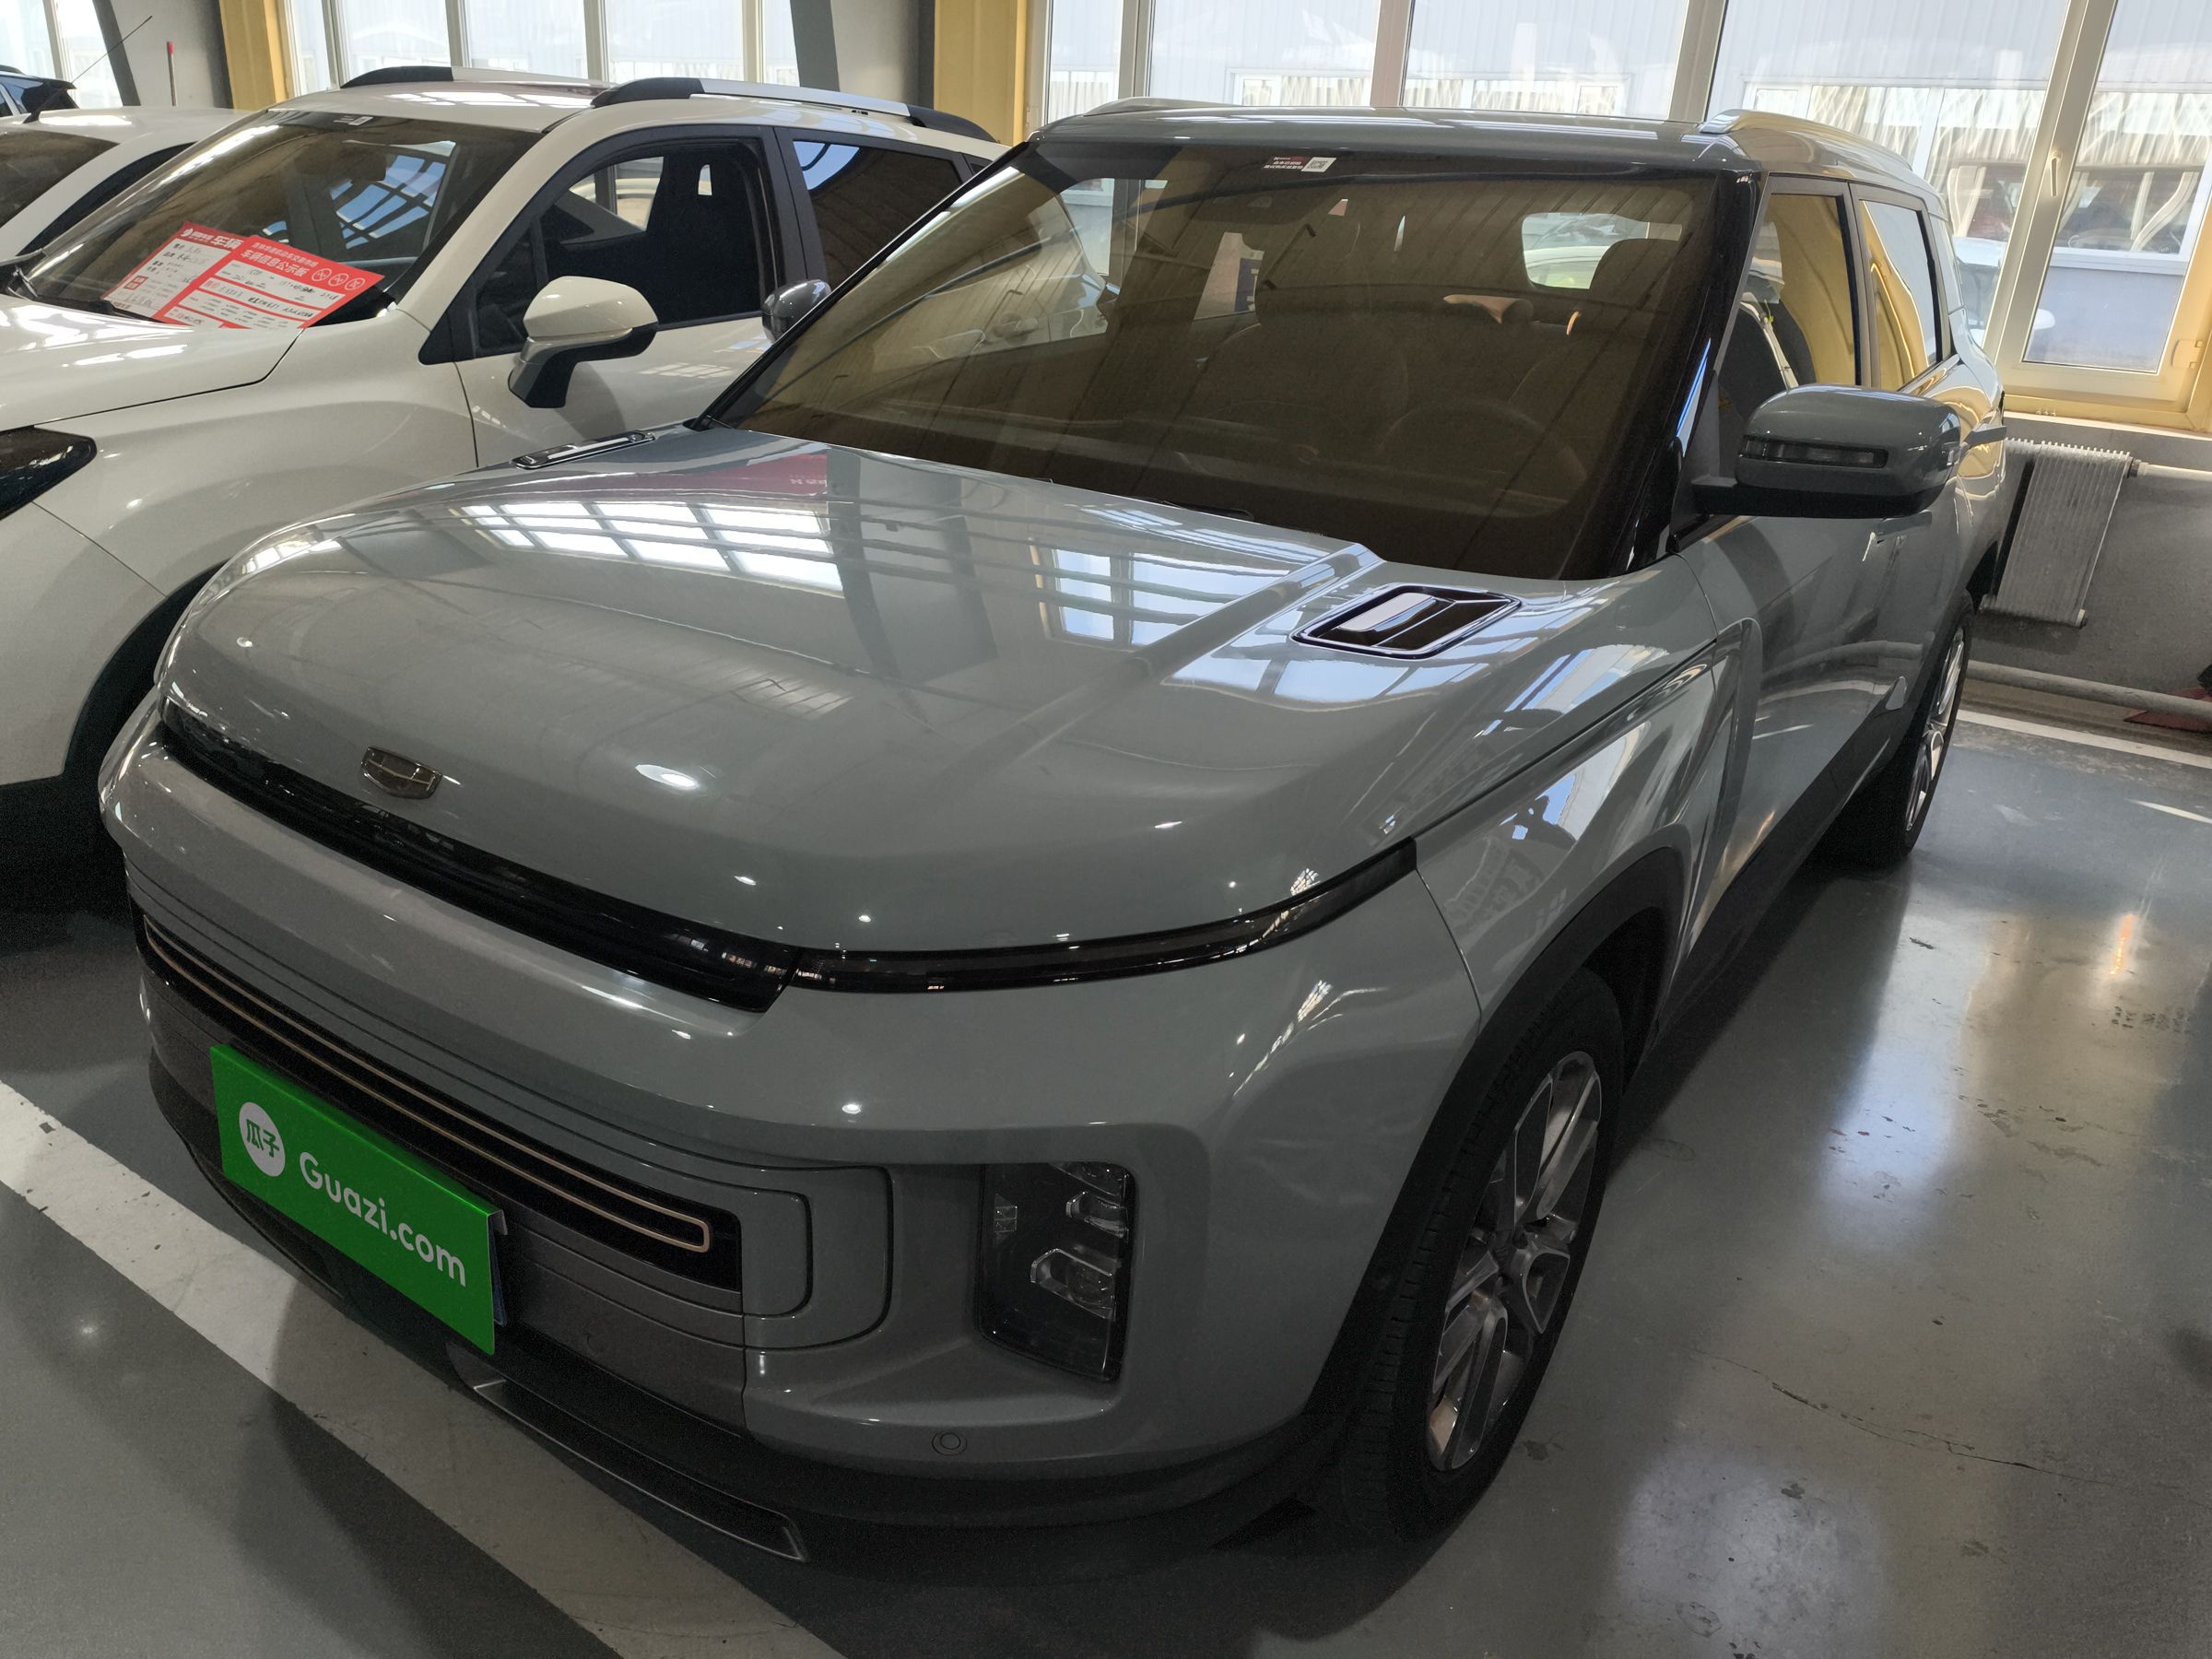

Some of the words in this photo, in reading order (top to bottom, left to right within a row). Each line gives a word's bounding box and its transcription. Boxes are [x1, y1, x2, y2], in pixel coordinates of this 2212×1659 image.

[241, 250, 310, 277] 车辆信息公示板
[245, 1118, 280, 1159] 瓜子
[299, 1151, 466, 1288] Guazi.com
